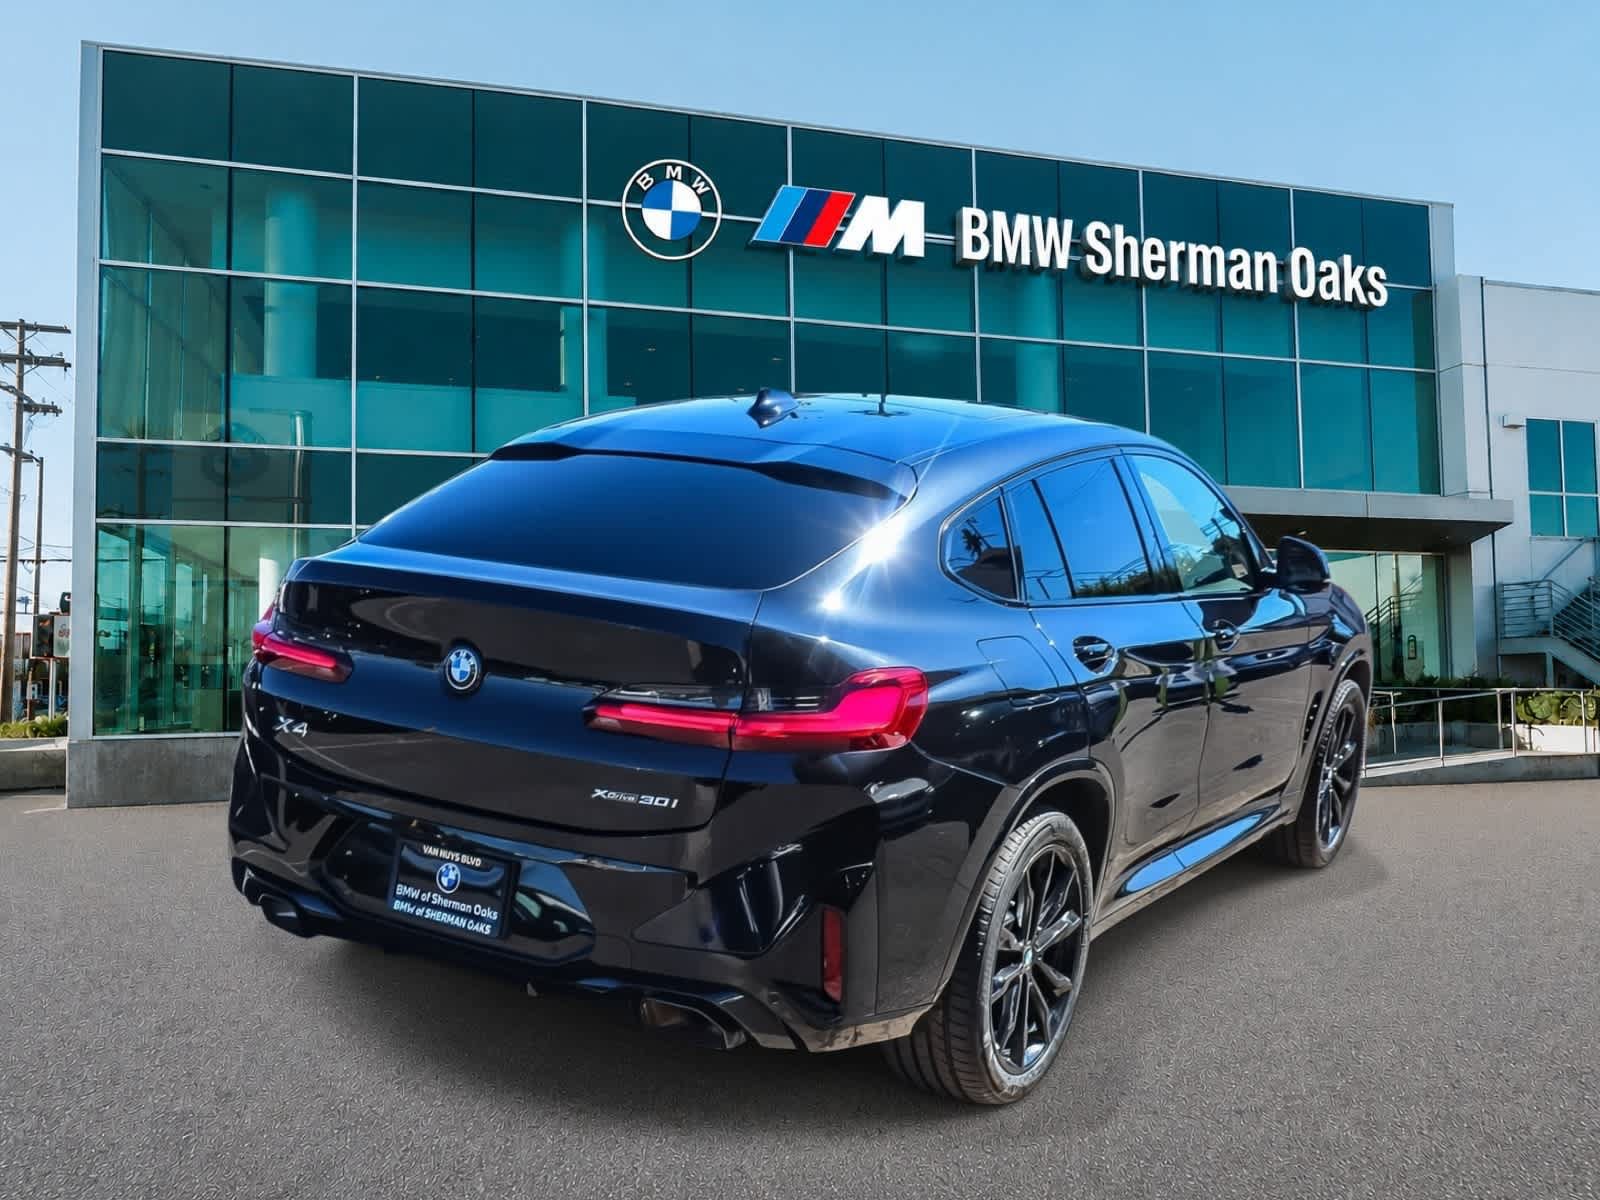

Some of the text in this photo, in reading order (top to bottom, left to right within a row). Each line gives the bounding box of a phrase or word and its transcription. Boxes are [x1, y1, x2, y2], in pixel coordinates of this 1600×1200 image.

[636, 165, 711, 195] BMW
[836, 194, 926, 258] M
[958, 206, 1389, 308] BMW Sherman Oaks
[274, 715, 308, 738] X4
[423, 845, 439, 856] VAN
[460, 854, 482, 868] BLVD
[393, 900, 491, 935] BMW of SHERMAN OAKS
[396, 884, 498, 920] BMW of Sherman Oaks
